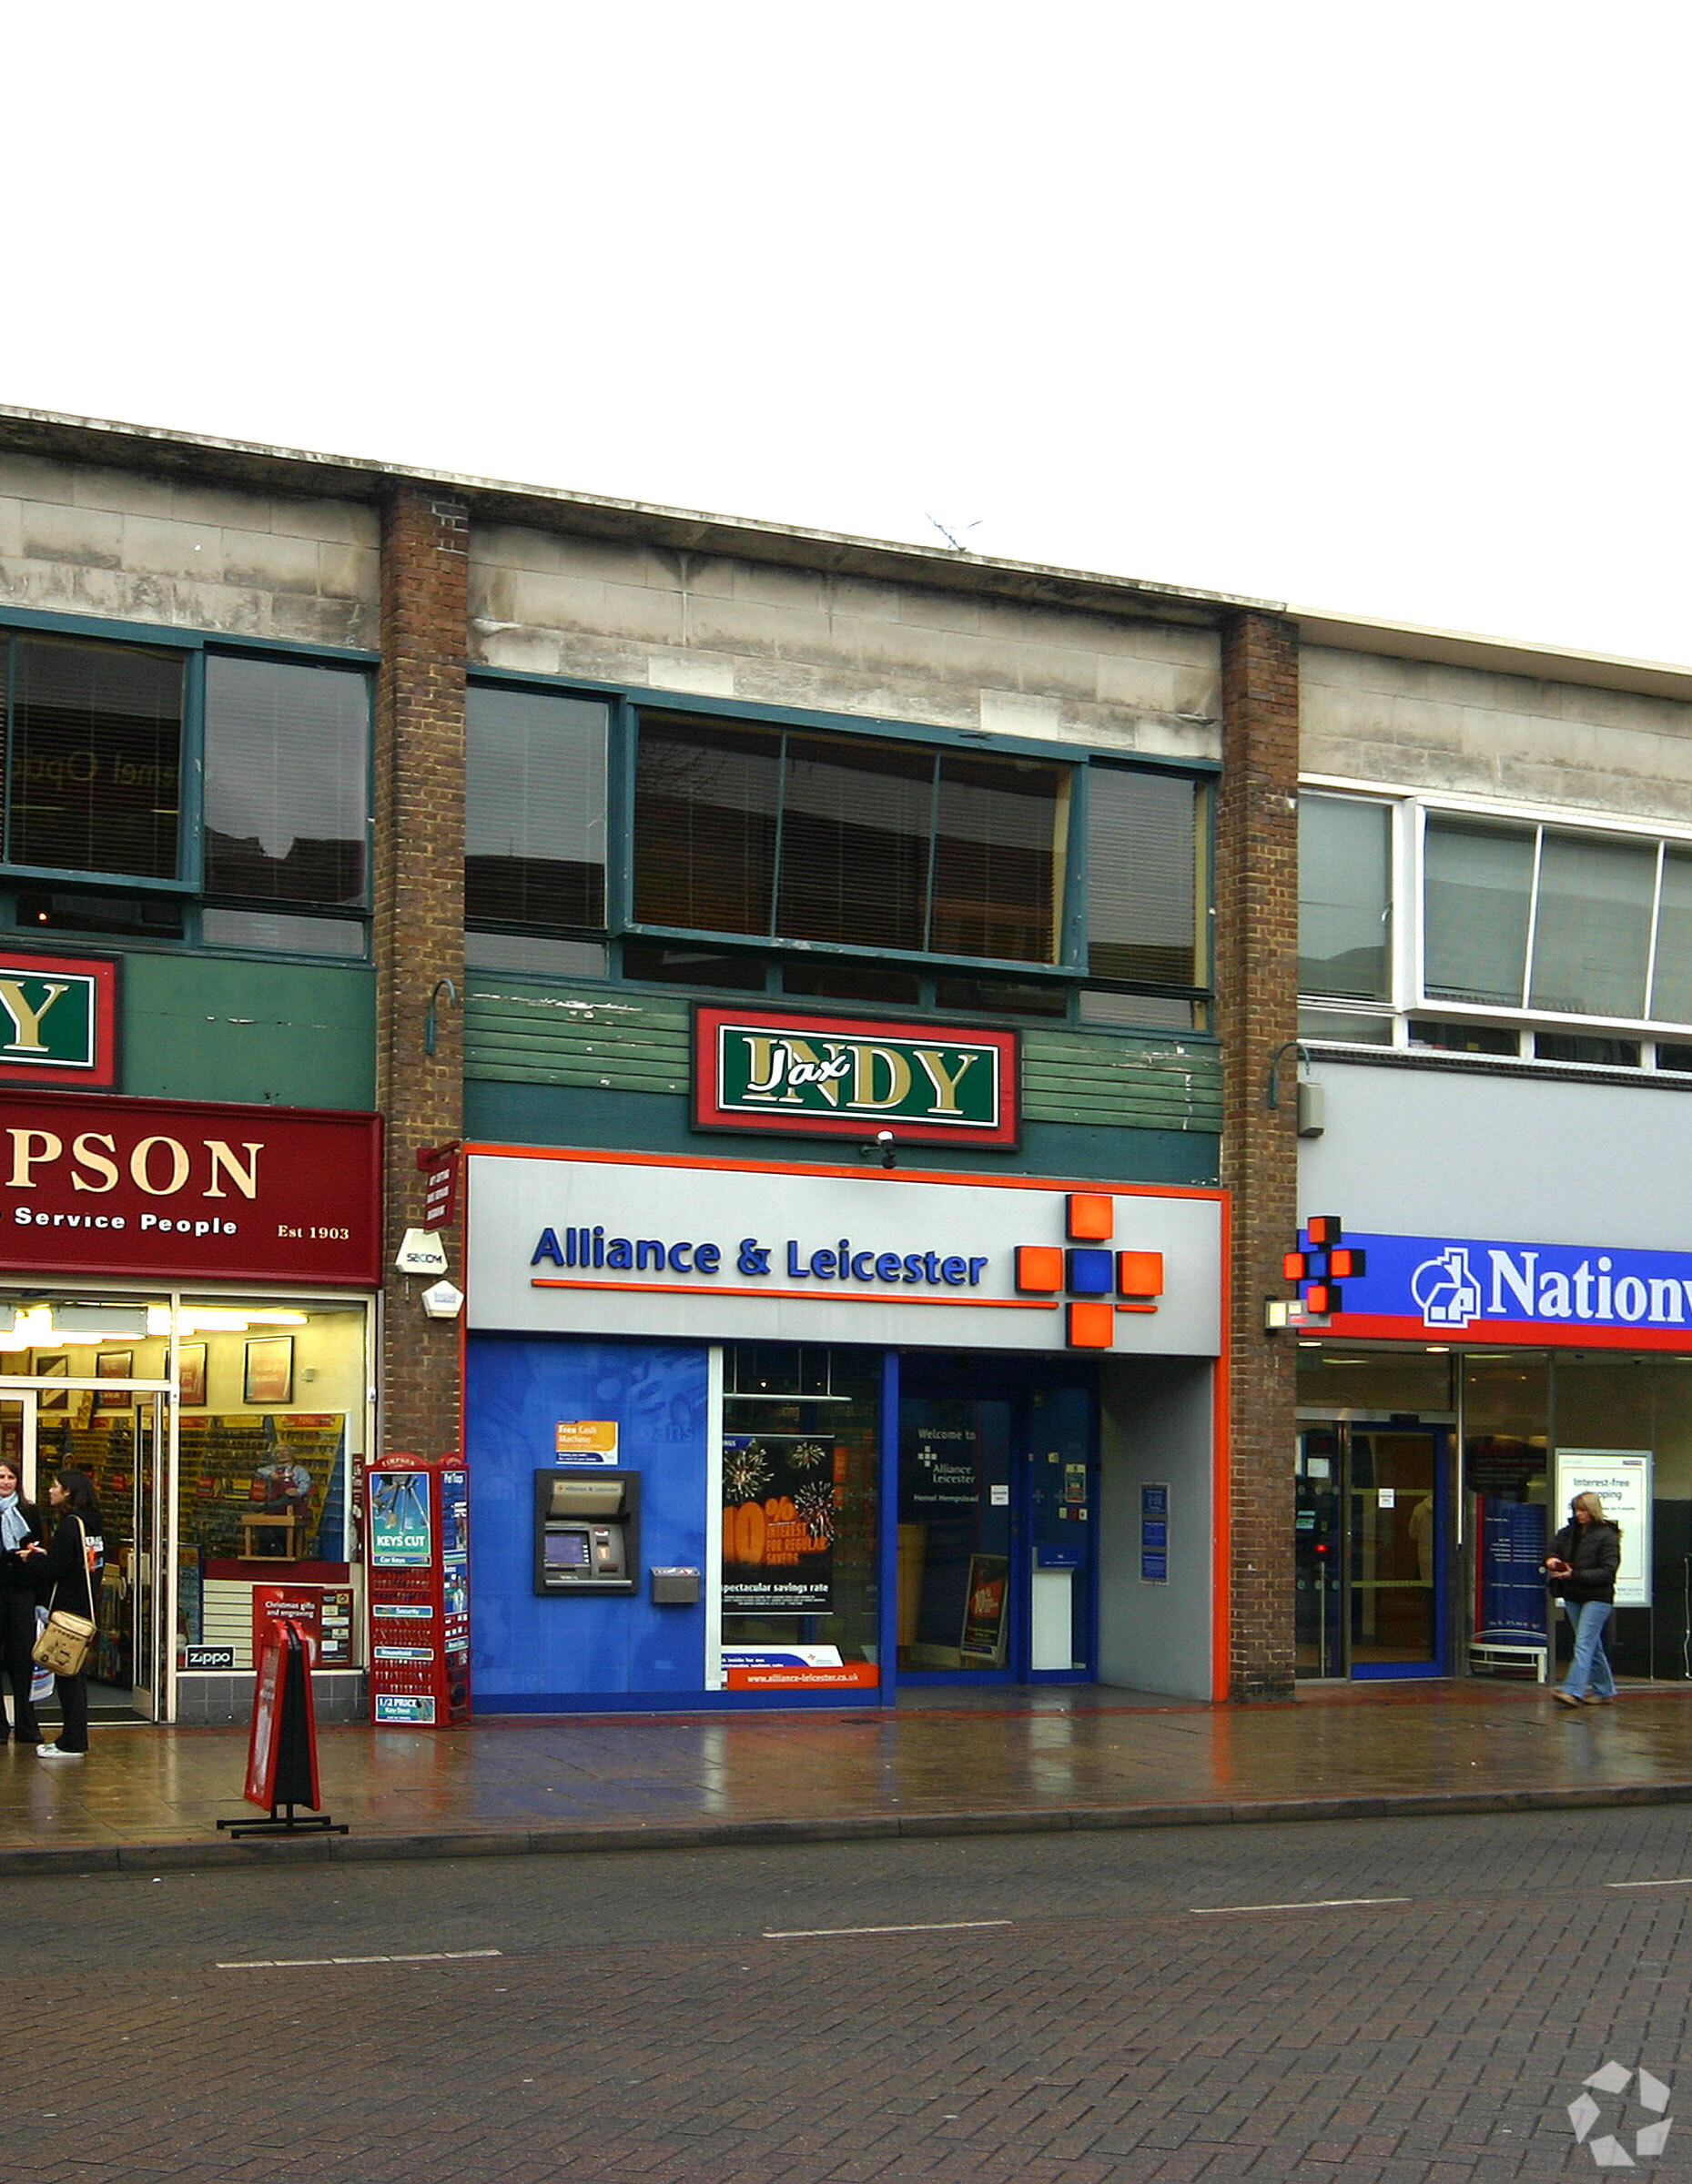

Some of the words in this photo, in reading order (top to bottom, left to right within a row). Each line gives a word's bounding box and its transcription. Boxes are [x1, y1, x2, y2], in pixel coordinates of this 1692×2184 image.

[0, 980, 70, 1052] Y
[746, 1048, 851, 1092] Jax
[5, 1128, 265, 1199] PSON
[15, 1207, 125, 1229] Service
[141, 1214, 238, 1236] People
[278, 1225, 302, 1239] Est
[309, 1227, 350, 1239] 1903
[532, 1226, 721, 1274] Alliance
[737, 1239, 772, 1276] &
[786, 1239, 988, 1287] Leicester
[917, 1429, 963, 1441] Welcome
[966, 1430, 978, 1441] to
[933, 1463, 972, 1474] Alliance
[933, 1474, 977, 1484] Leicester
[377, 1535, 403, 1547] KEYS
[404, 1535, 426, 1547] CUT
[774, 1582, 807, 1594] savings
[810, 1583, 829, 1592] rate
[265, 1601, 299, 1609] Christmas
[300, 1601, 316, 1611] gifts
[189, 1650, 231, 1665] zippo
